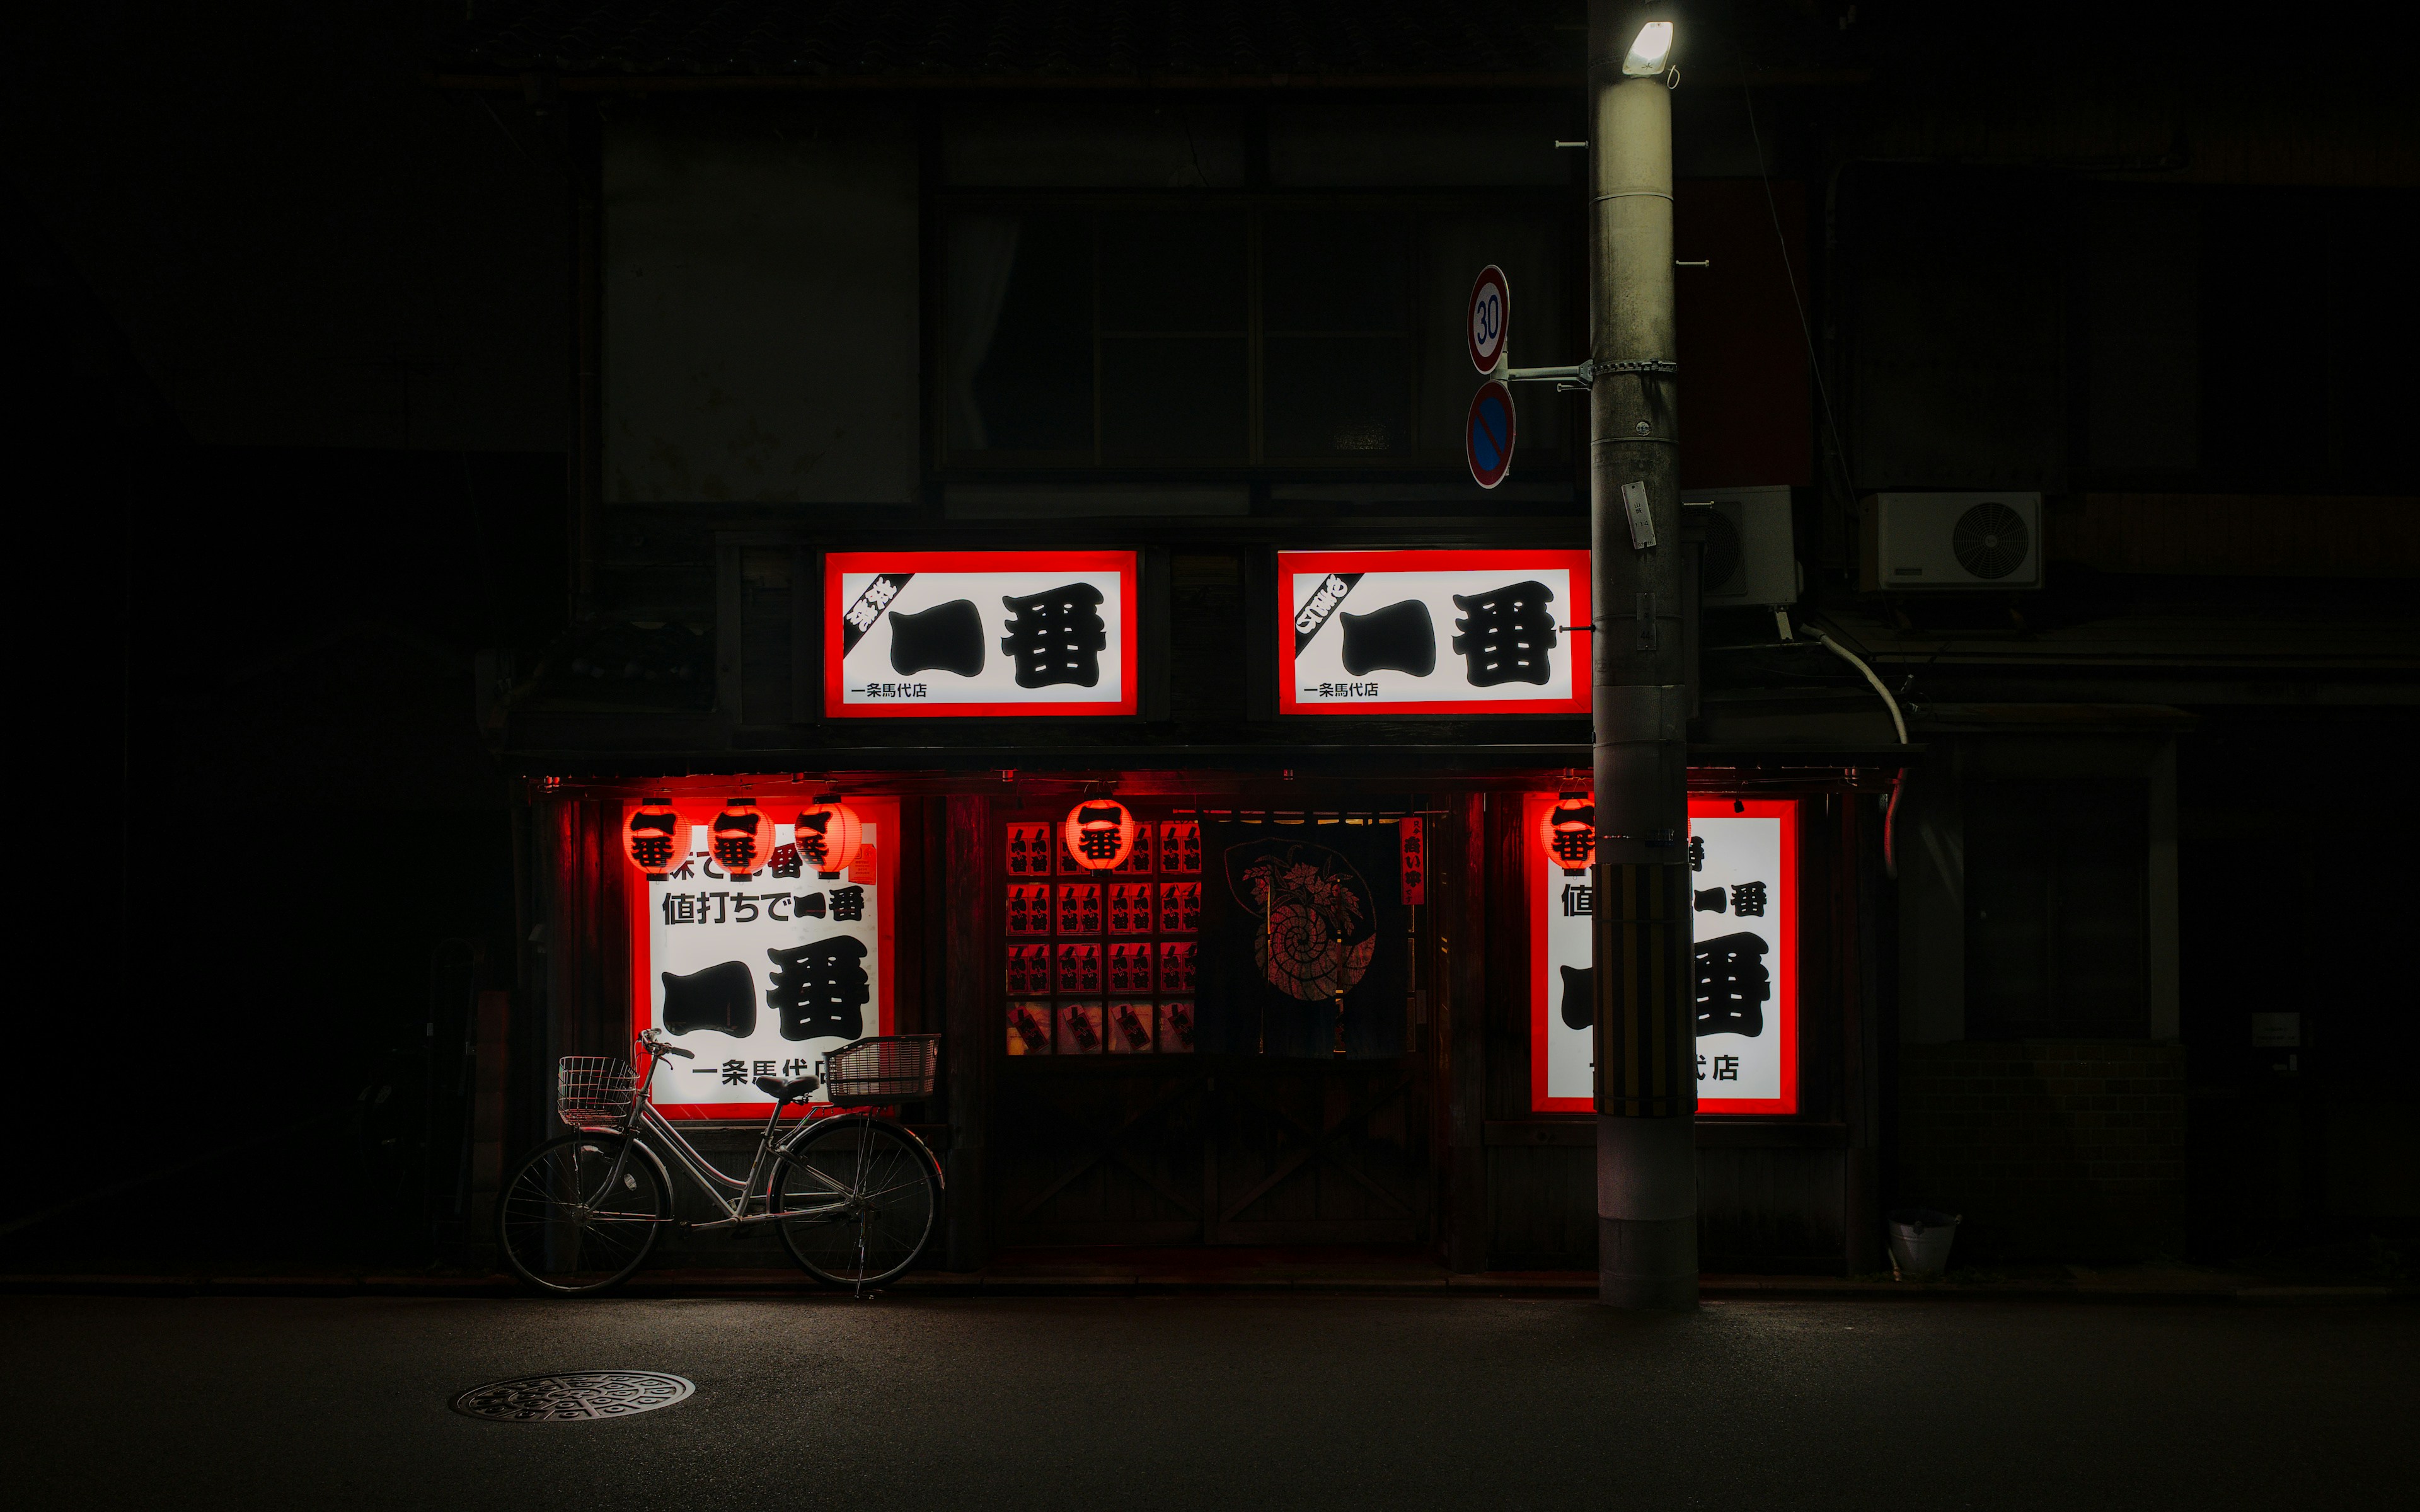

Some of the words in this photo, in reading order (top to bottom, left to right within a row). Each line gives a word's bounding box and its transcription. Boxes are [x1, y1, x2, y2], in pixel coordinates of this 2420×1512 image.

[1477, 294, 1499, 345] 30
[889, 582, 1106, 689] 一番
[1340, 580, 1557, 687] 一番
[851, 683, 926, 698] 一条馬代店
[1304, 682, 1378, 697] 一条馬代店
[630, 810, 677, 868] 一番
[714, 811, 760, 868] 一番
[794, 810, 832, 867] 一番
[1077, 805, 1122, 861] 一番
[1552, 805, 1595, 862] 一番
[662, 885, 865, 925] 値打ちで一番
[661, 935, 870, 1041] 一番
